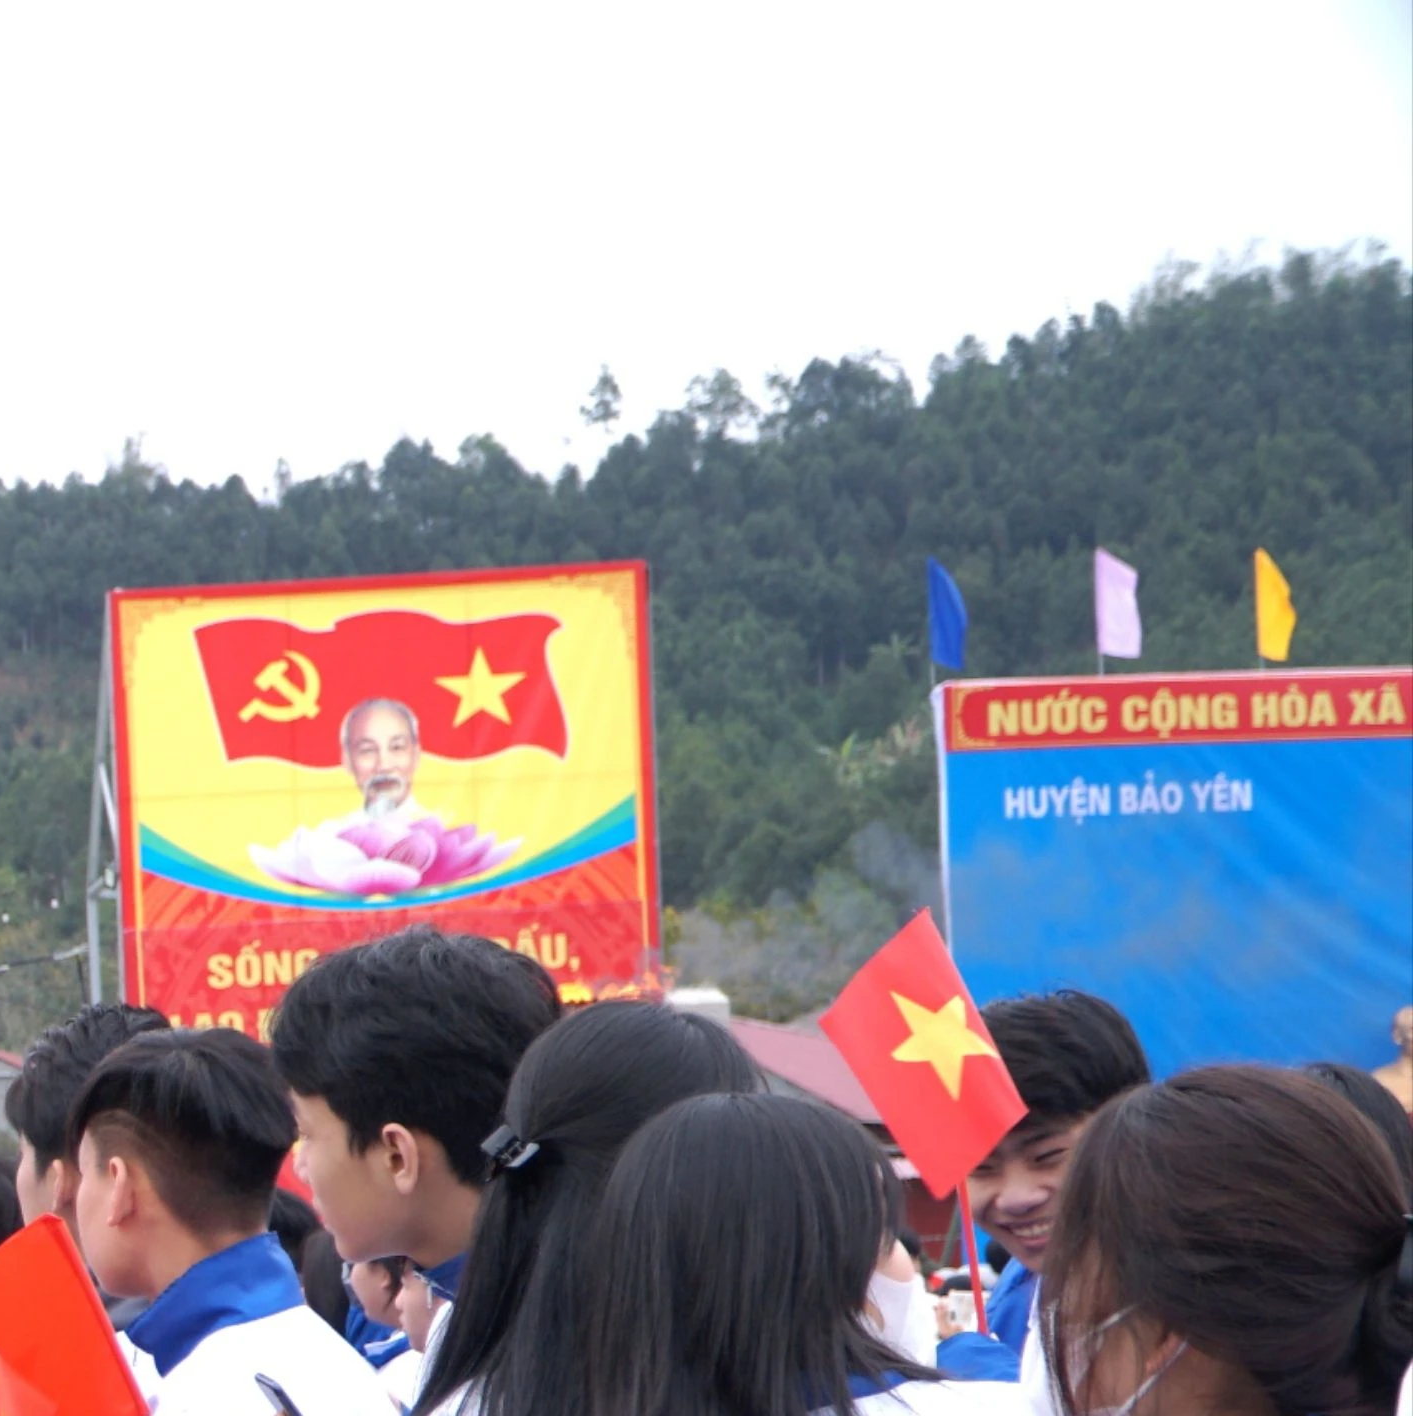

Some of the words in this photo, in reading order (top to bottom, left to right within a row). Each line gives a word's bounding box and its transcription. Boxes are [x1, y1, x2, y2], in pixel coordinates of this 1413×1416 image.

[987, 688, 1108, 736] NƯỚC
[1121, 687, 1239, 739] CỘNG
[1348, 682, 1407, 725] XÃ
[1004, 776, 1111, 826] HUYỆN
[1119, 769, 1183, 815] BẢO
[1191, 772, 1253, 813] YÊN
[491, 923, 580, 972] ẤU,
